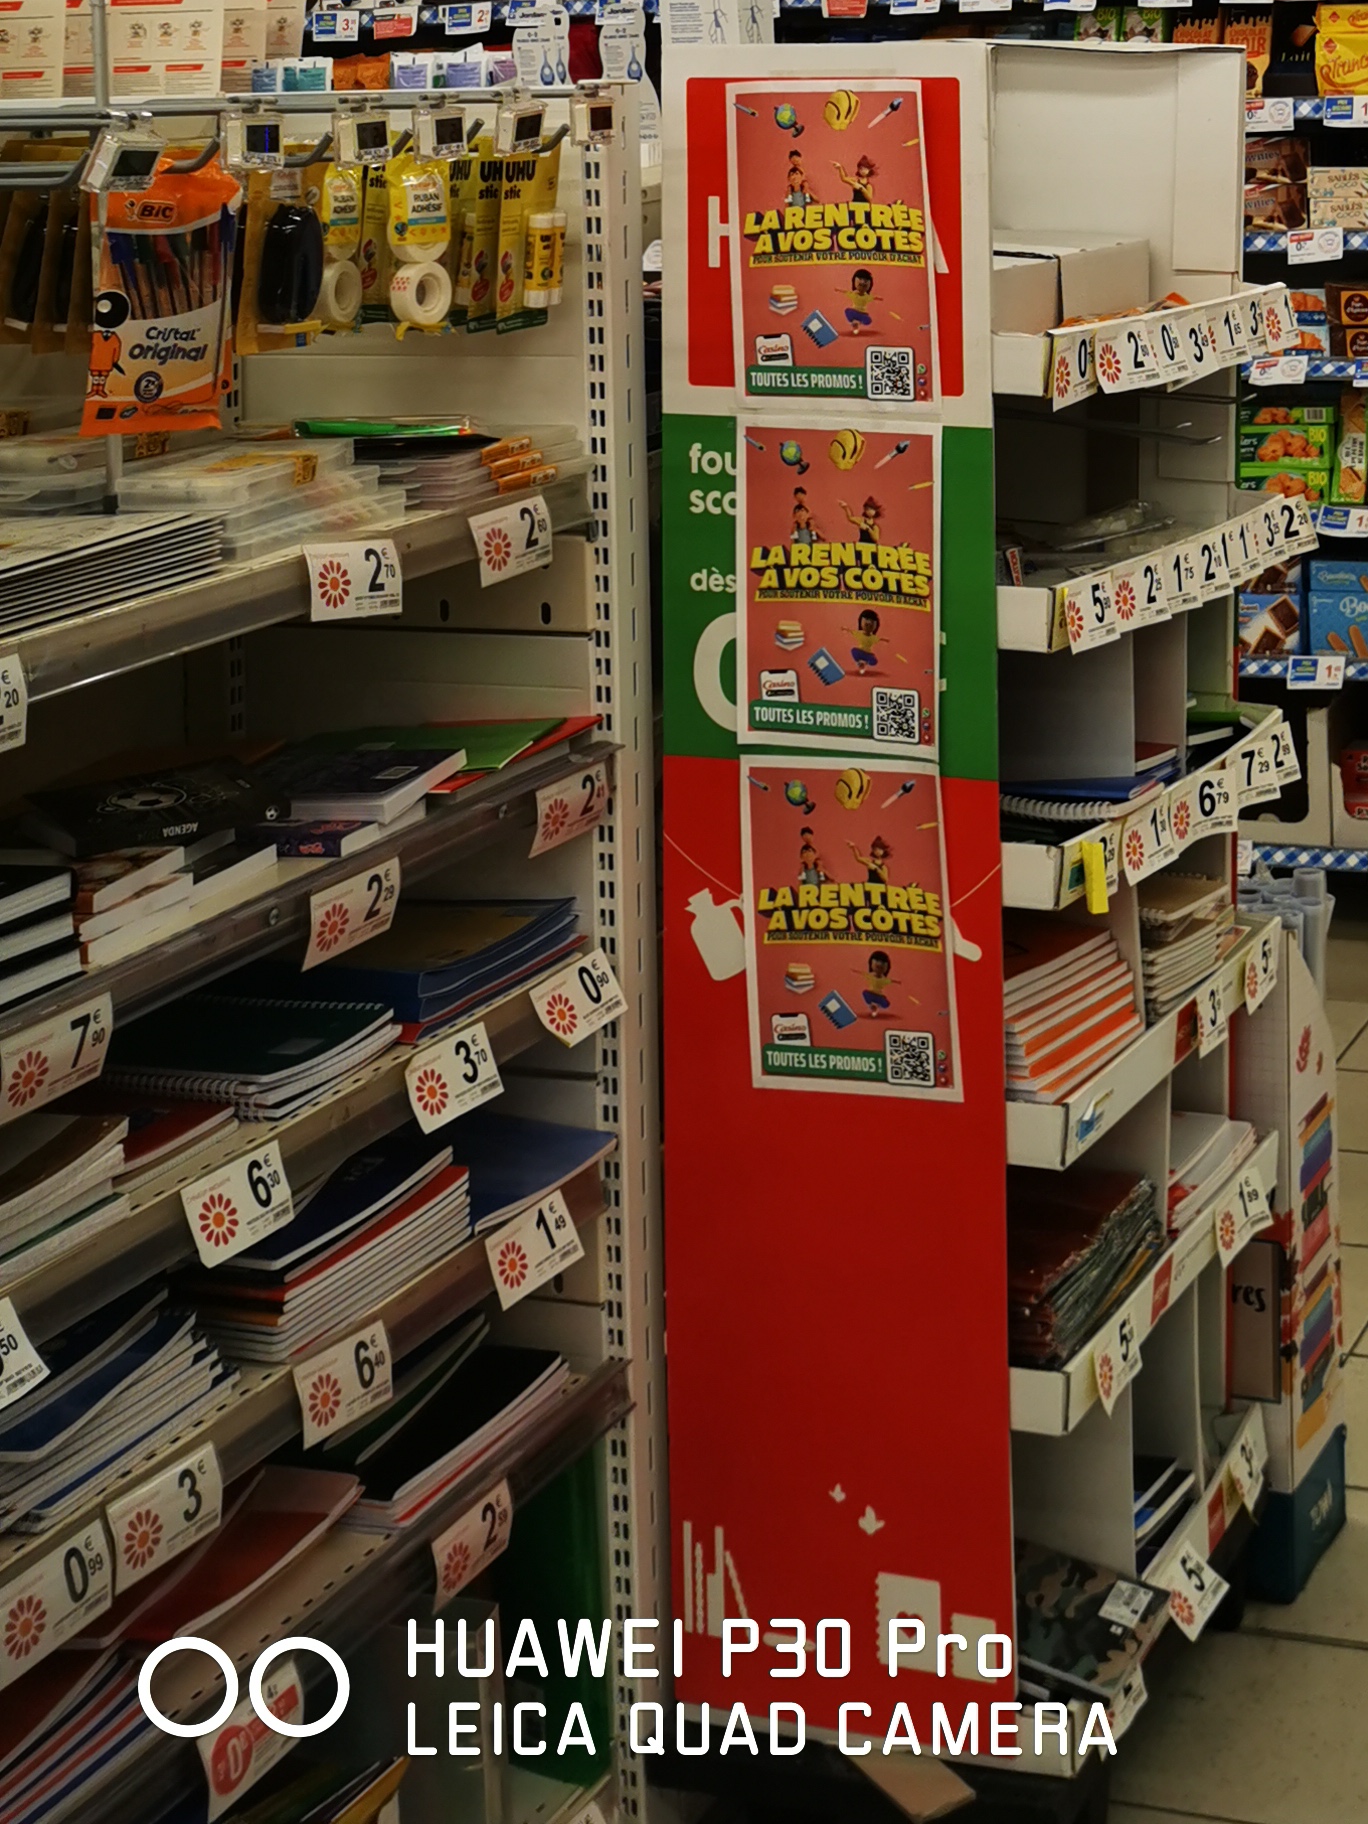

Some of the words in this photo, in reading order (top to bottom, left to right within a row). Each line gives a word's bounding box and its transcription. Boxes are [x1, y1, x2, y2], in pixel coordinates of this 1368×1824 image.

[1229, 27, 1266, 38] CHOCOLAT
[1230, 37, 1266, 50] NOIR
[505, 159, 537, 183] UHU
[413, 193, 440, 202] RUBAN
[479, 184, 498, 200] stic
[504, 184, 521, 201] stic
[411, 202, 443, 213] ADHÉSIF
[744, 210, 780, 234] LA
[784, 200, 925, 231] RENTRÉE
[753, 228, 774, 254] À
[777, 229, 832, 252] VOS
[837, 224, 924, 253] CÔTÉS
[817, 253, 846, 261] VOTRE
[128, 342, 208, 366] Original
[751, 372, 789, 387] TOUTES
[791, 373, 809, 387] LES
[811, 374, 856, 389] PROMOS
[1310, 428, 1326, 442] BIO
[1309, 472, 1326, 486] BIO
[751, 546, 786, 568] LA
[790, 541, 932, 576] RENTRÉE
[759, 565, 780, 589] À
[784, 568, 839, 589] VOS
[845, 565, 931, 596] CÔTÉS
[754, 707, 793, 723] TOUTES
[796, 709, 814, 724] LES
[816, 711, 862, 728] PROMOS
[162, 821, 199, 838] AGENDA
[758, 886, 794, 911] LA
[799, 882, 943, 918] RENTRÉE
[768, 907, 788, 931] À
[793, 908, 848, 930] VOS
[854, 905, 941, 936] CÔTÉS
[767, 1051, 806, 1068] TOUTES
[808, 1053, 827, 1069] LES
[829, 1055, 876, 1073] PROMOS
